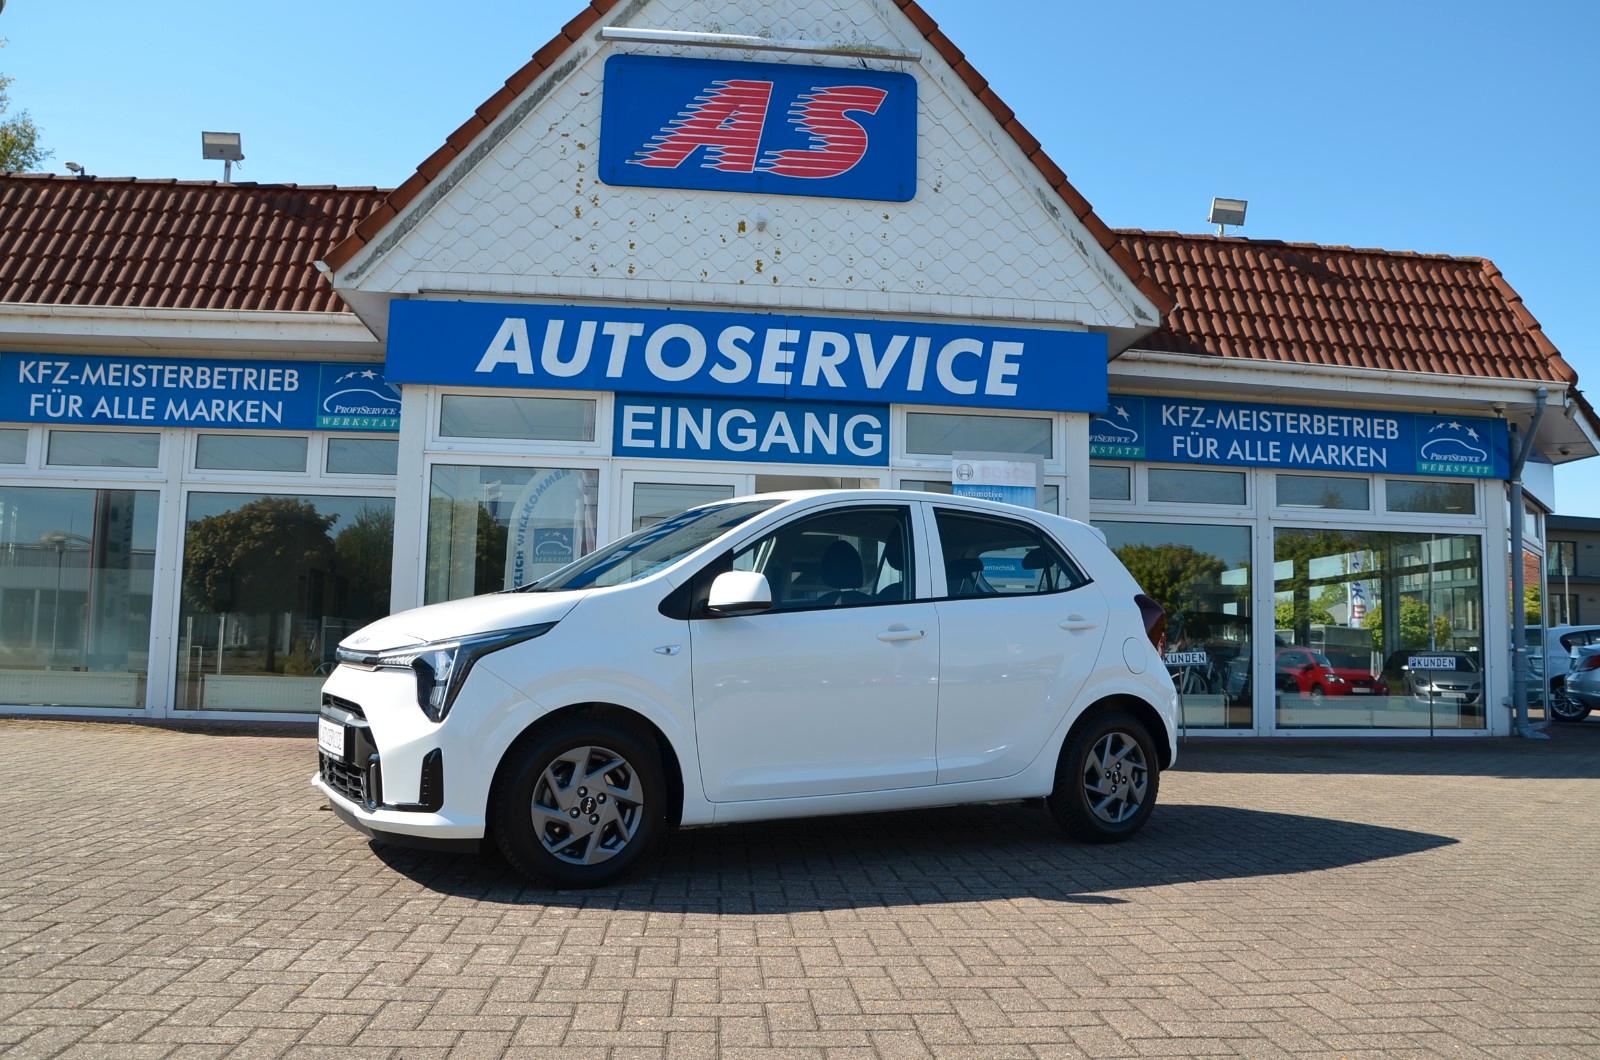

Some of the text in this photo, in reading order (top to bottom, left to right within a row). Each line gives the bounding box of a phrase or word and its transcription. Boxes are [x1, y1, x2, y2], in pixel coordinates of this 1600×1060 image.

[625, 79, 889, 179] AS
[475, 317, 1024, 396] AUTOSERVICE
[18, 360, 299, 392] KFZ-MEISTERBETRIEB
[30, 388, 283, 424] FÜR ALLE MARKEN
[322, 417, 398, 427] WERKSTAT
[622, 405, 882, 457] EINGANG
[1162, 405, 1399, 440] KFZ-MEISTERBETRIEB
[1091, 446, 1140, 455] KSTATT
[1173, 431, 1387, 468] FÜR ALLE MARKEN
[1421, 464, 1489, 474] WERKSTATT
[957, 489, 1003, 498] Automotive
[513, 551, 525, 588] ZLICH
[983, 563, 1016, 571] entechnik
[1163, 652, 1206, 664] KUNDEN
[1417, 658, 1454, 667] KUNDEN
